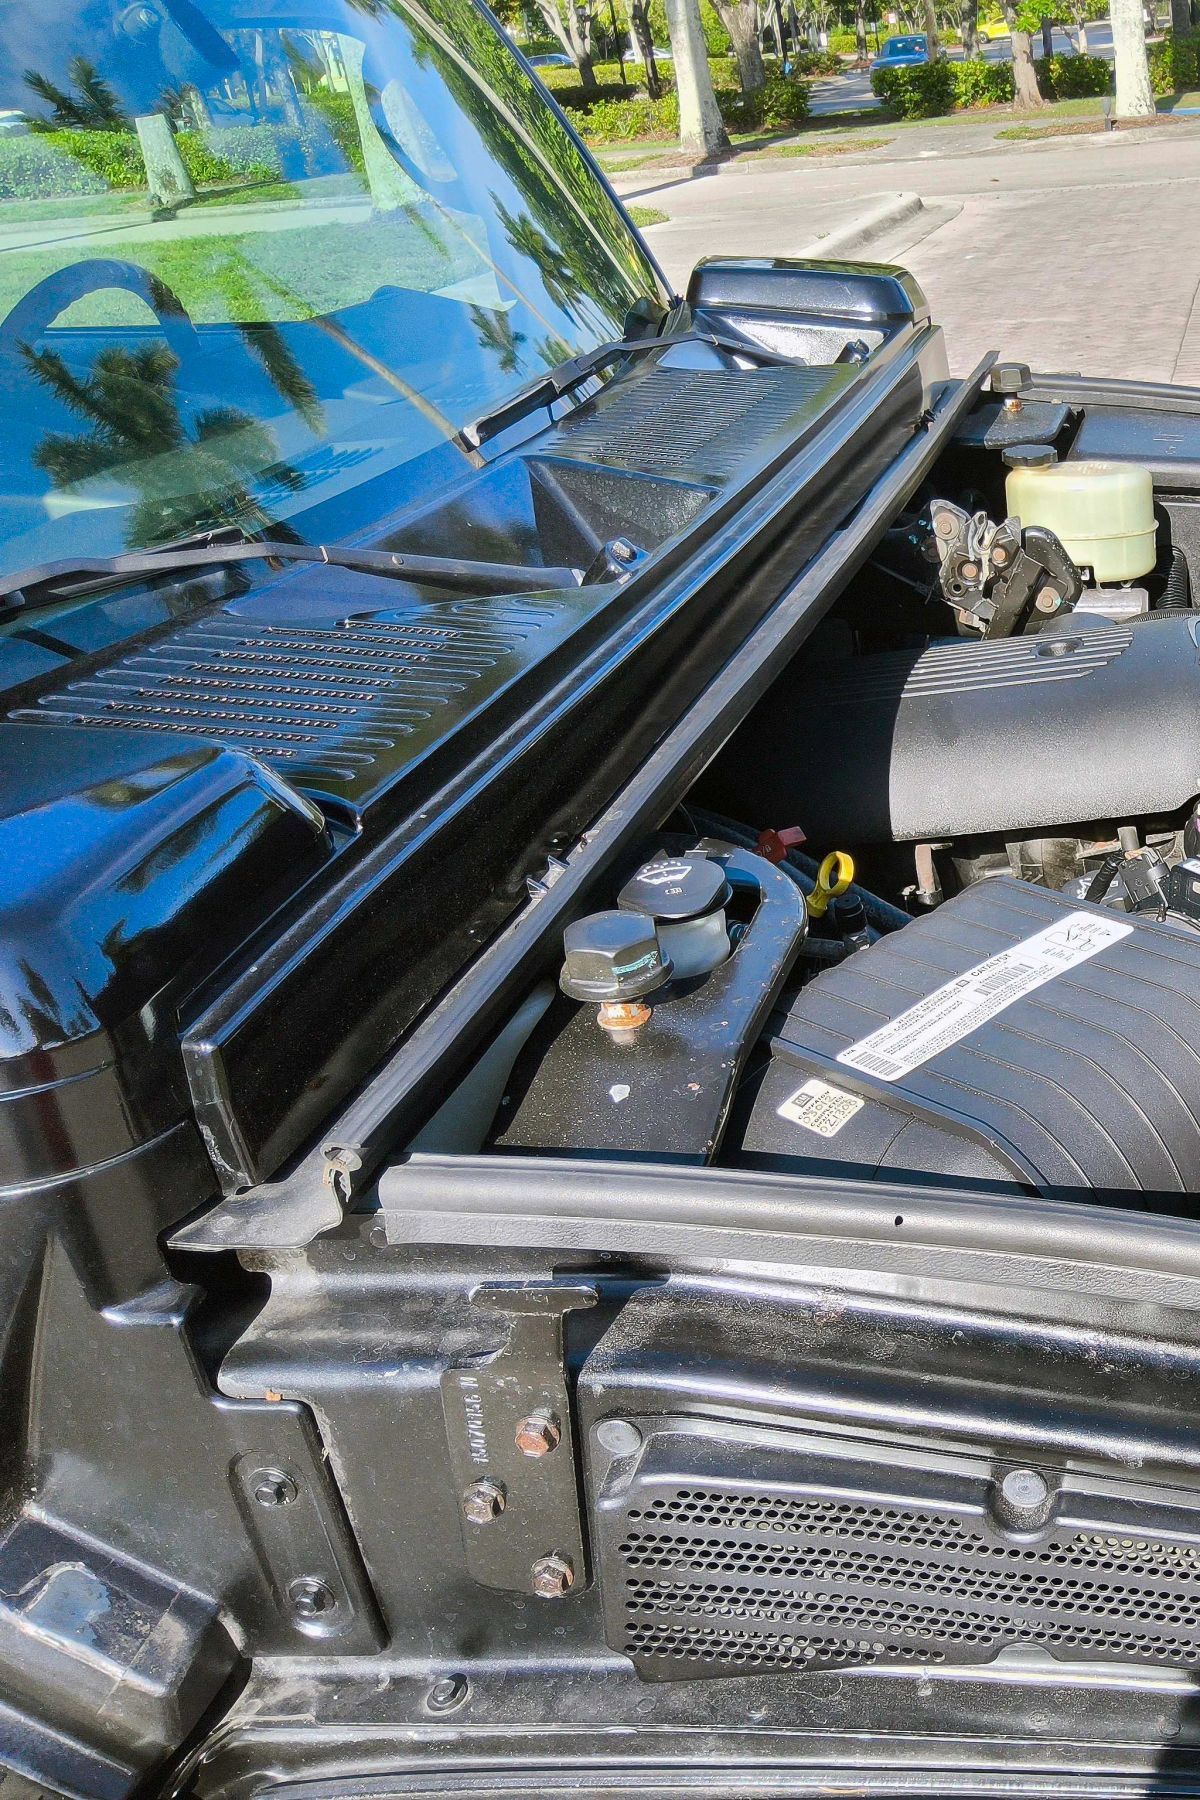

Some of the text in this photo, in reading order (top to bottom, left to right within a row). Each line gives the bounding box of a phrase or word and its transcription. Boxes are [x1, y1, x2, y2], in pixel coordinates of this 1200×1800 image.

[971, 953, 1011, 977] CATALYST
[798, 1090, 830, 1120] CAMPAIGN
[810, 1095, 844, 1127] COMPLETED
